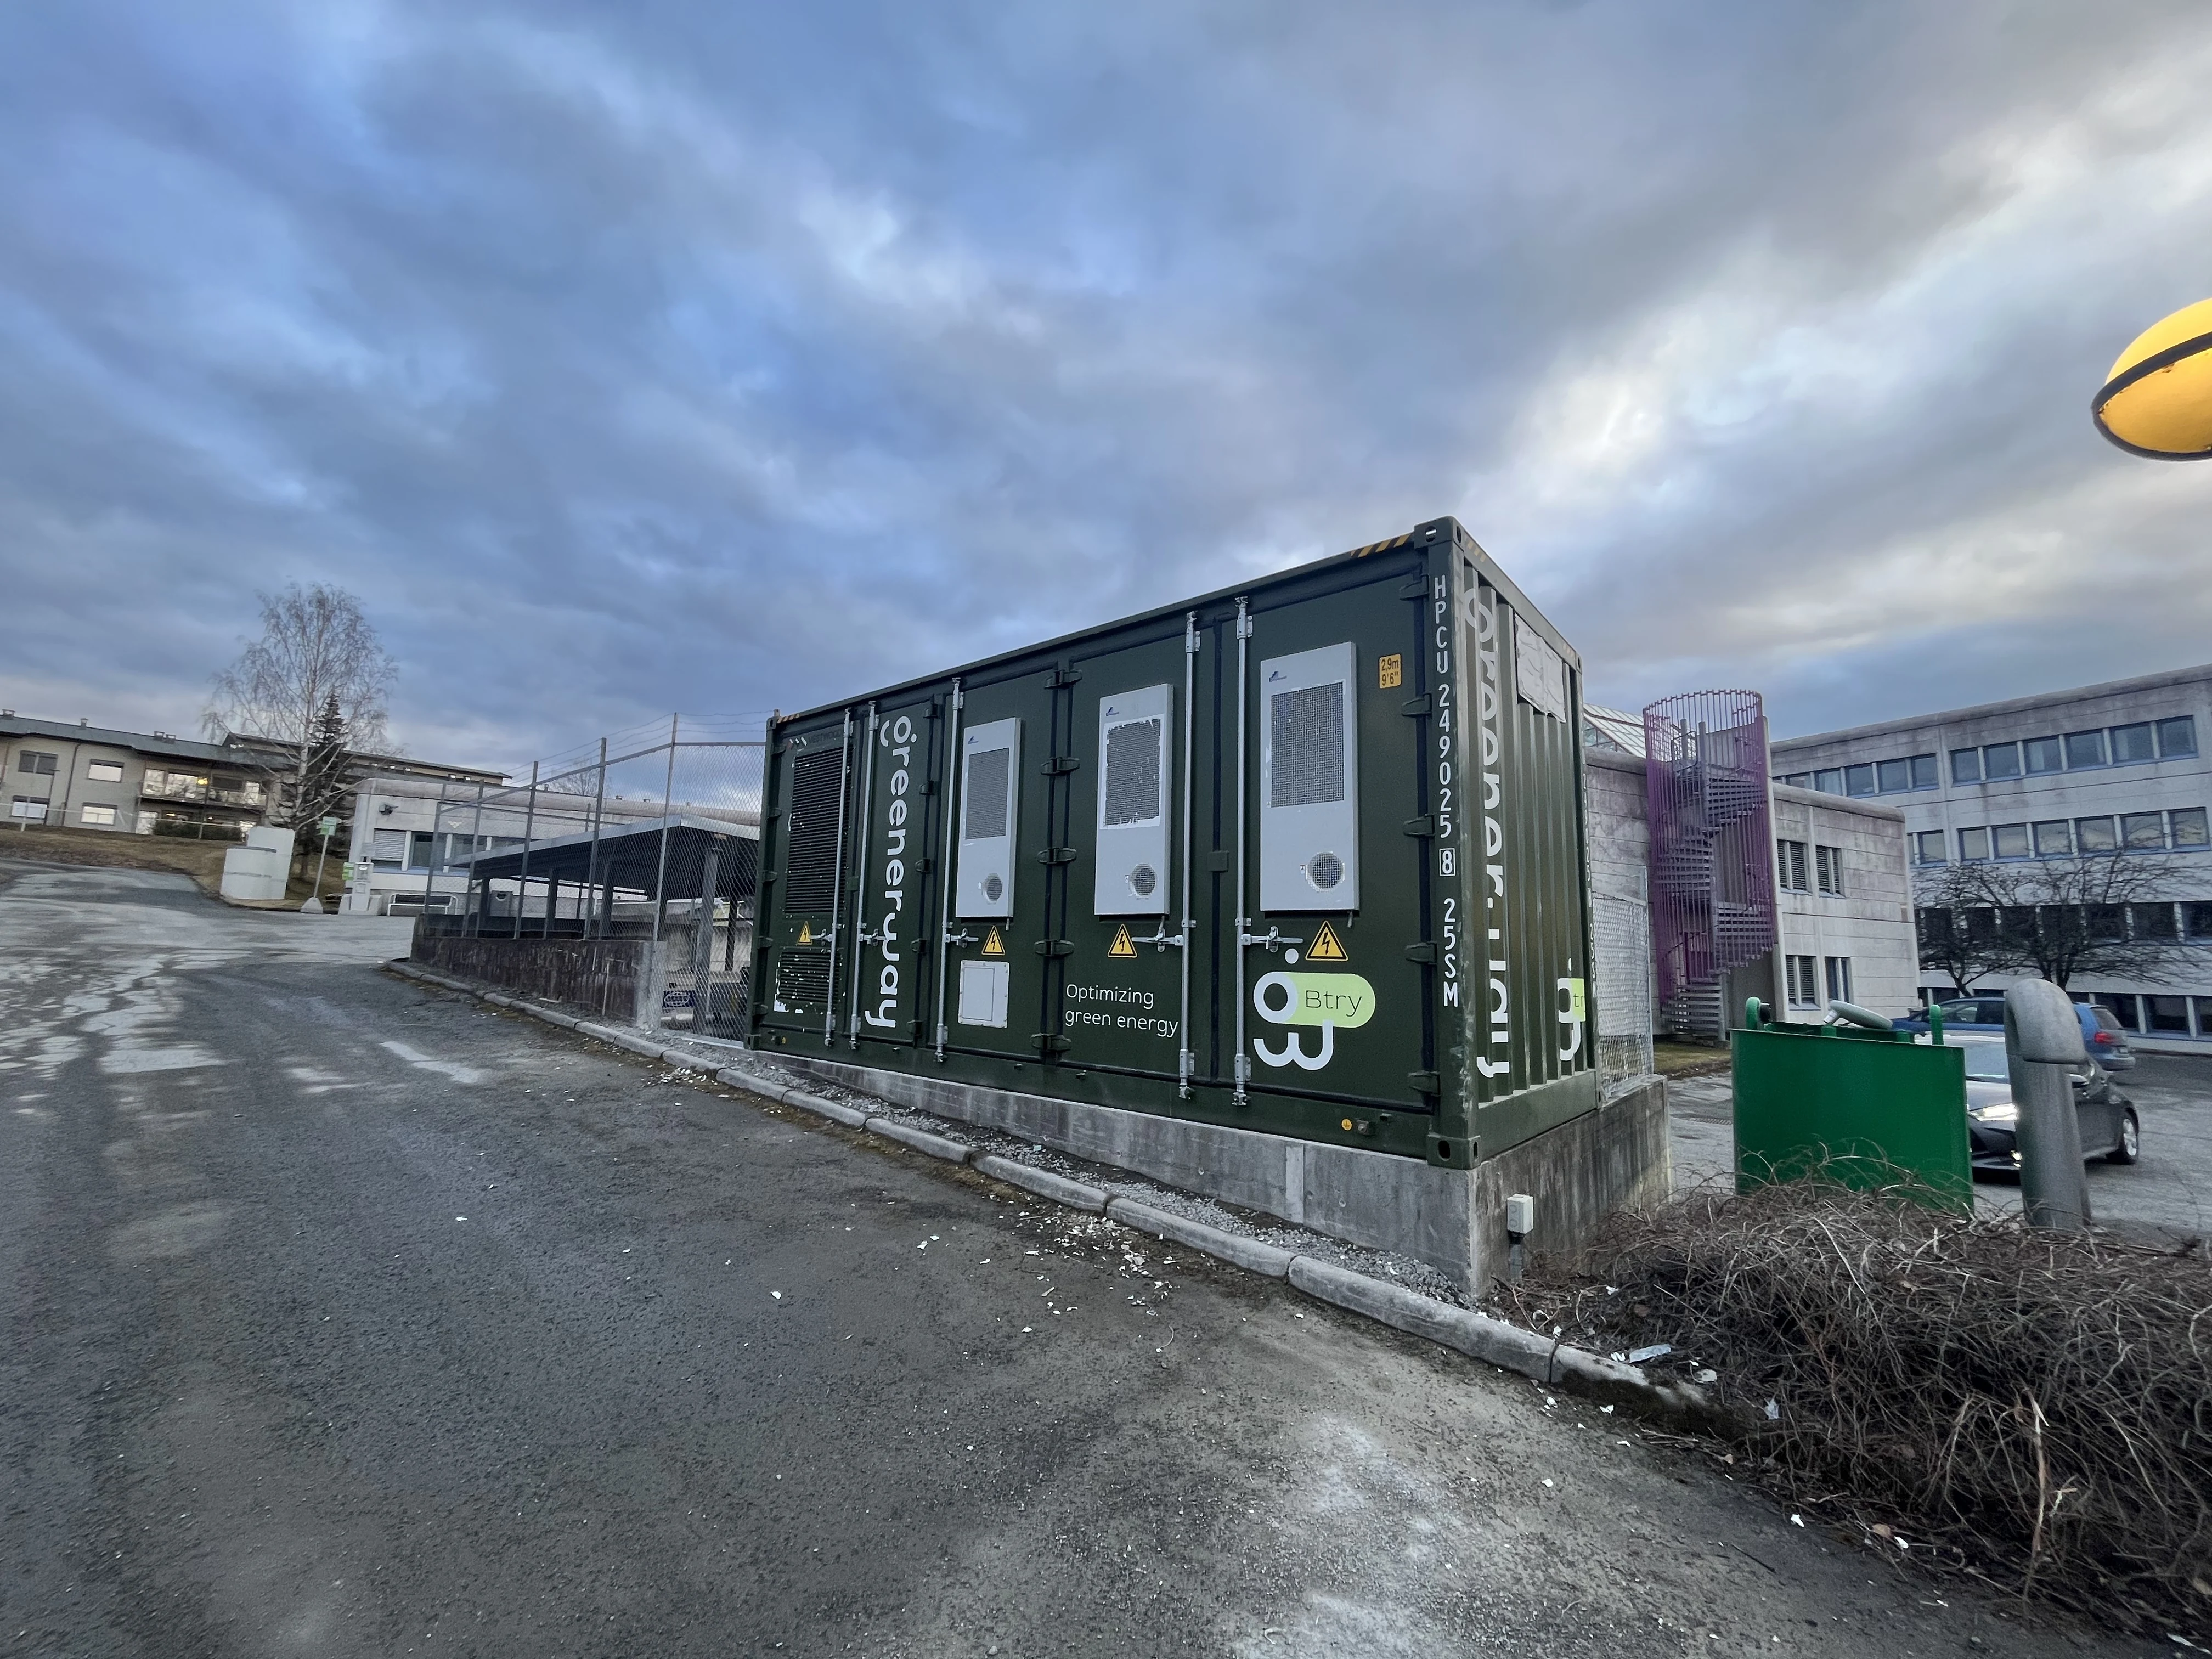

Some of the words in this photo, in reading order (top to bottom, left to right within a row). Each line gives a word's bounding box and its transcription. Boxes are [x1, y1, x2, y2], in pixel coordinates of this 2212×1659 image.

[1434, 575, 1448, 674] HPCU
[1438, 684, 1452, 838] 249025
[1442, 850, 1453, 874] 8
[1066, 984, 1154, 1009] Optimizing
[1306, 990, 1362, 1017] Btry
[1065, 1011, 1111, 1026] green
[1117, 1015, 1178, 1038] energy
